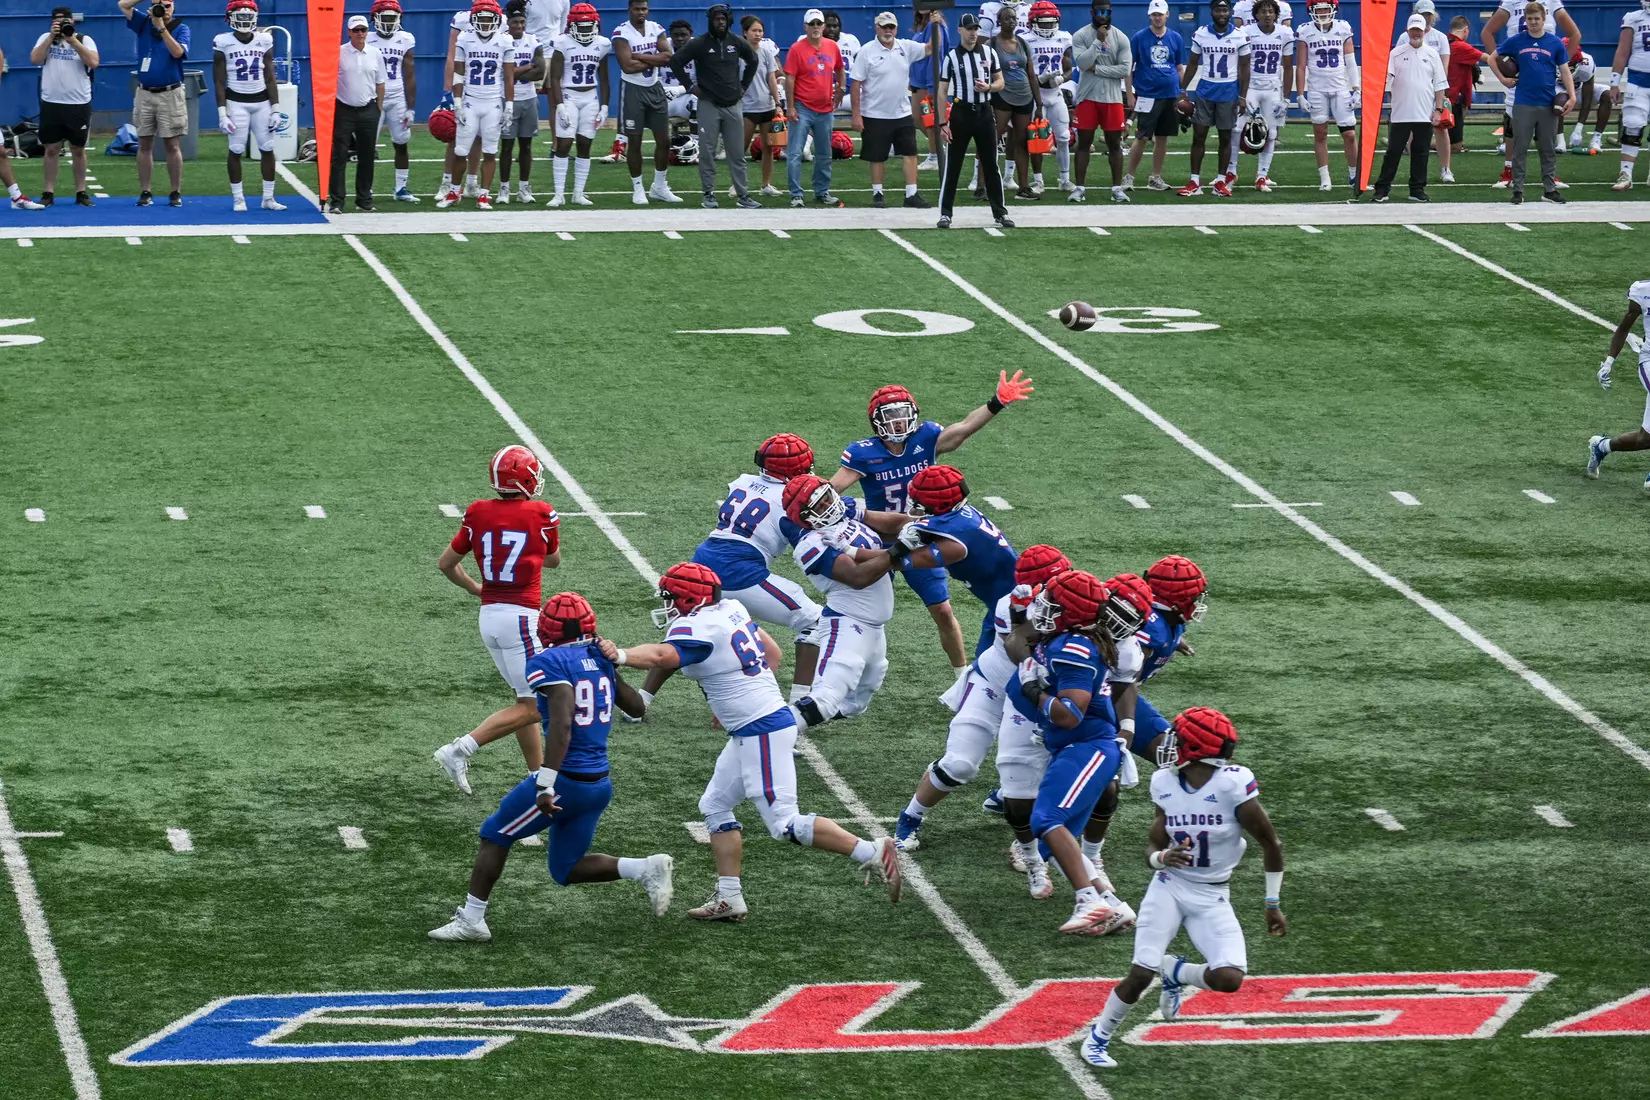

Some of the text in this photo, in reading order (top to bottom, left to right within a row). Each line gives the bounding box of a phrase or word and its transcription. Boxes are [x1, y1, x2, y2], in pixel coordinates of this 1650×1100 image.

[632, 42, 658, 52] BULLDOG
[1309, 40, 1342, 48] BULLDOGS
[235, 57, 260, 81] 24
[570, 54, 600, 63] BULLDOGS
[1208, 54, 1228, 78] 14
[1253, 51, 1280, 74] 28
[1315, 48, 1340, 68] 36
[469, 60, 498, 85] 22
[572, 62, 596, 84] 32
[876, 459, 928, 480] BULLDOGS
[748, 482, 769, 494] WHITE
[716, 488, 770, 538] 68
[481, 530, 528, 583] 17
[574, 676, 612, 726] 93
